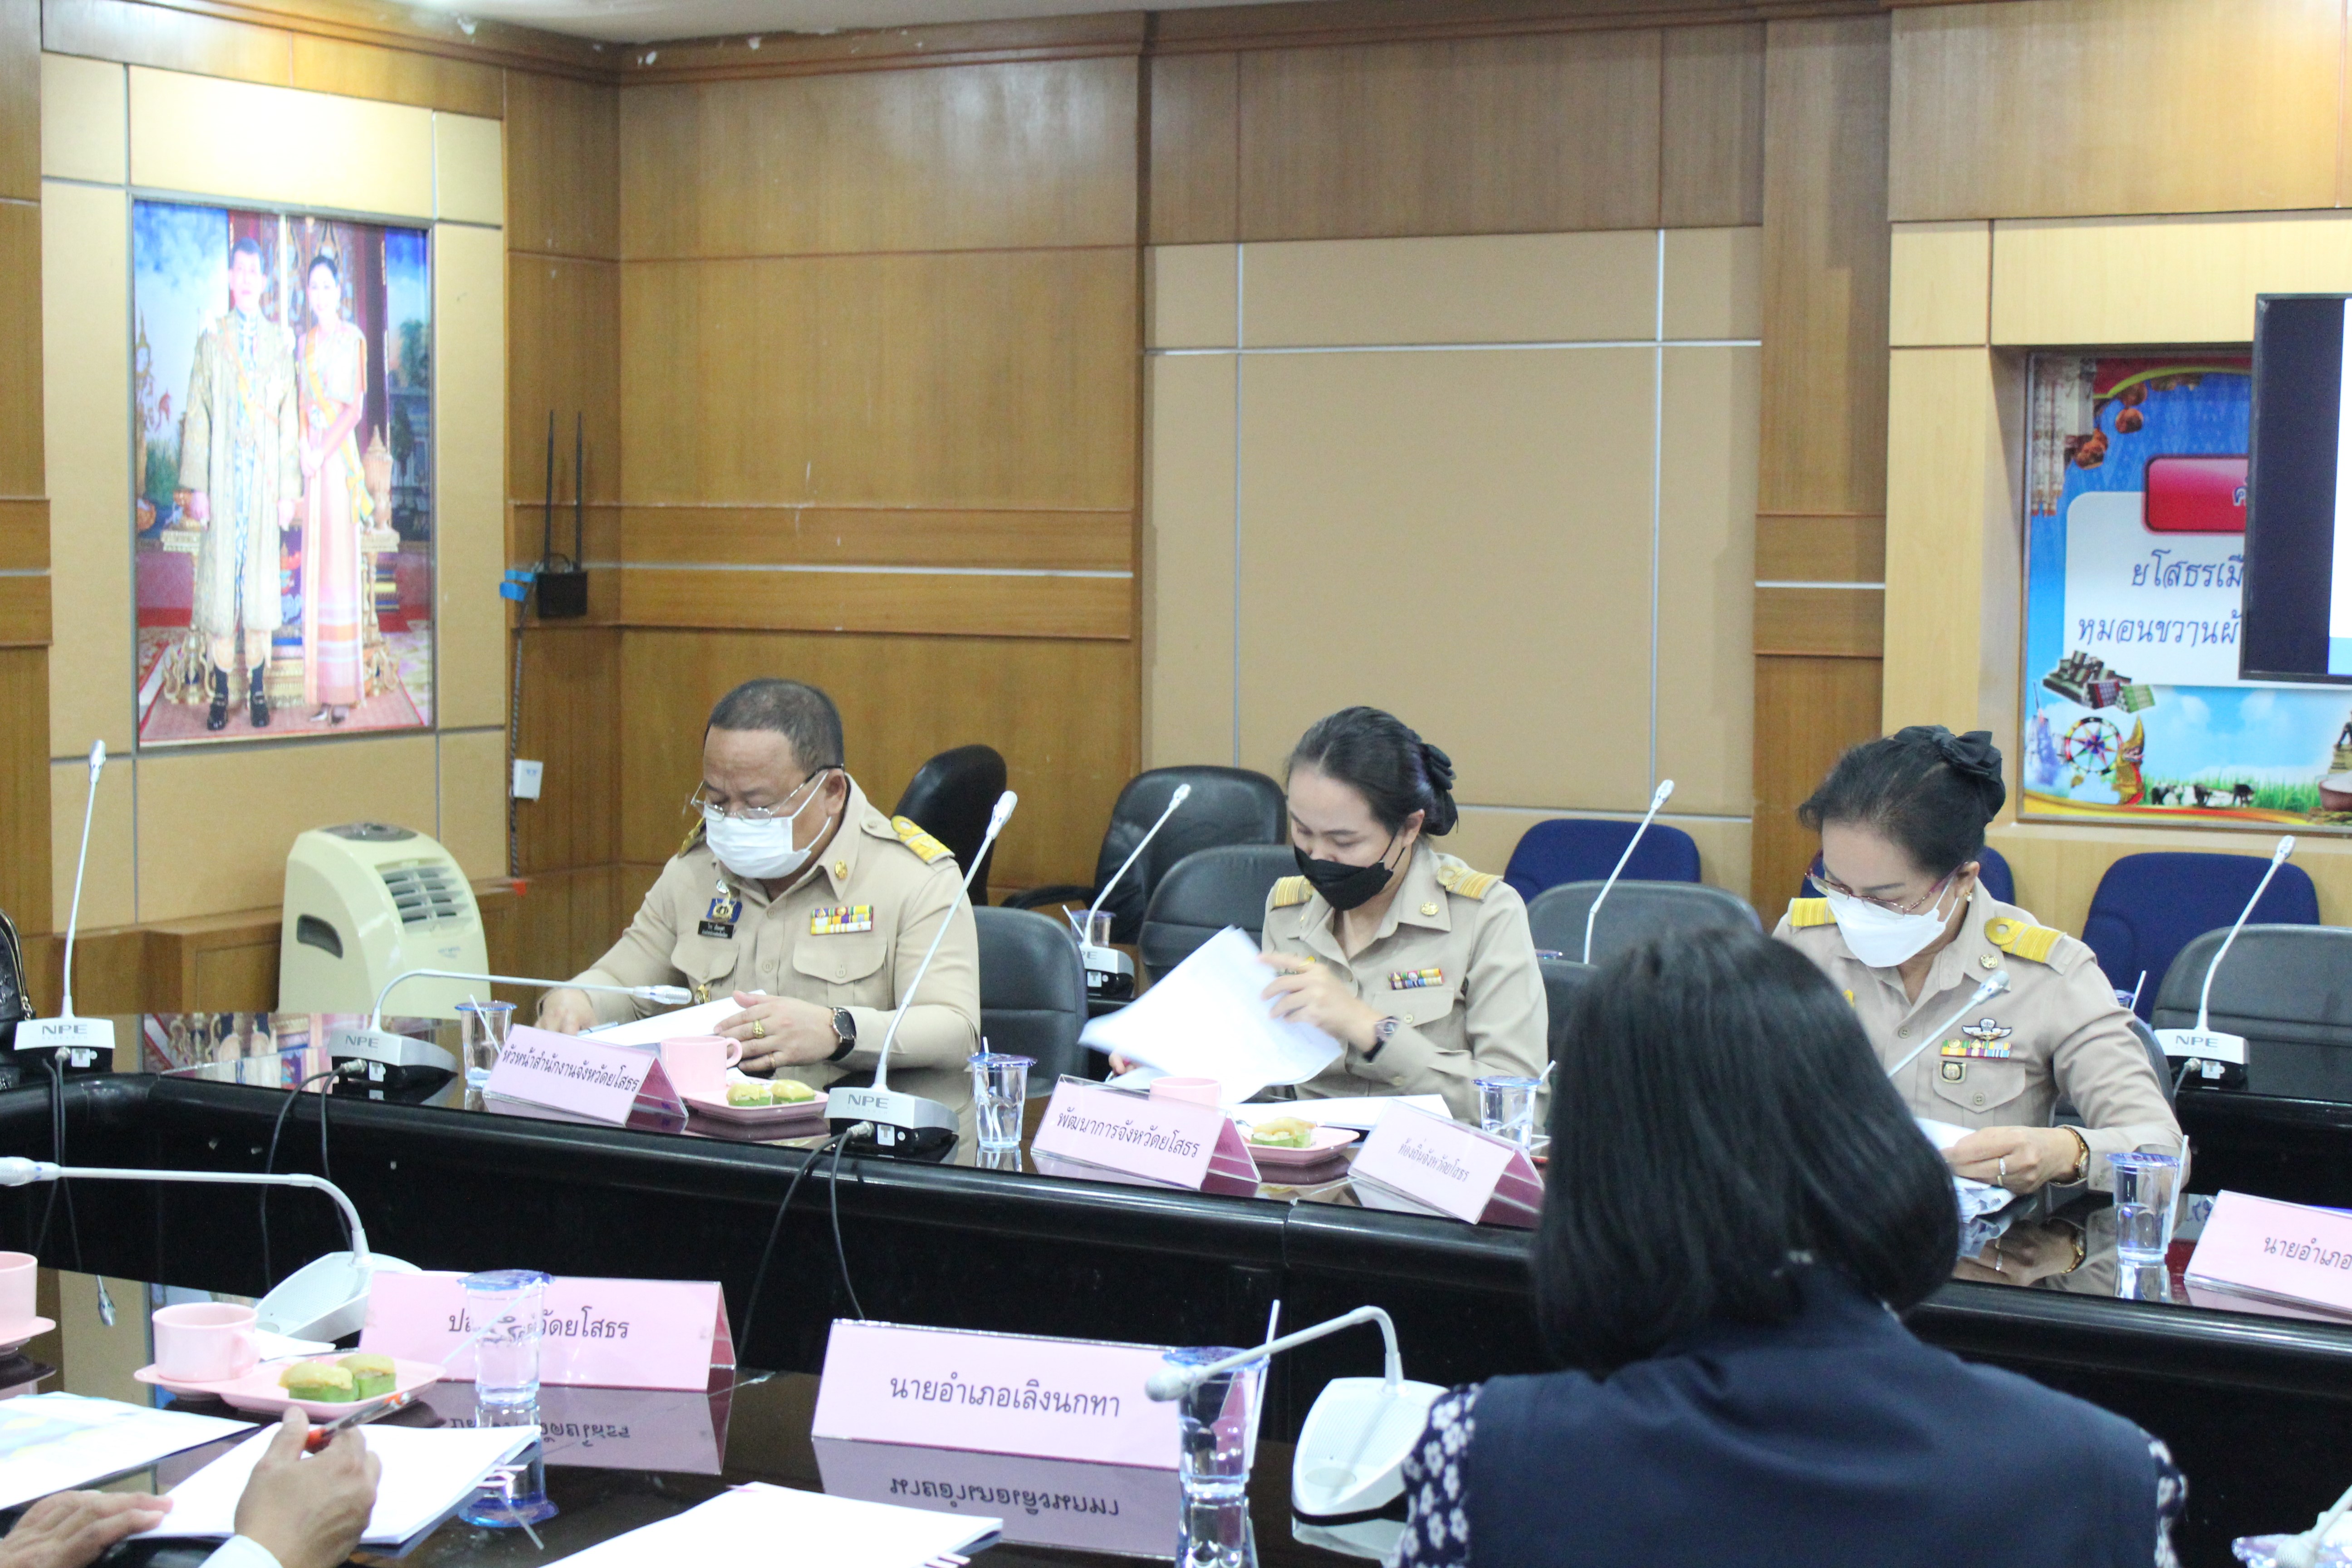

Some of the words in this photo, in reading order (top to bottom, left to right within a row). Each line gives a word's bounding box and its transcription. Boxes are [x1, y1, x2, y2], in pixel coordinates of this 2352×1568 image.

[42, 1024, 88, 1035] NPE
[345, 1034, 379, 1049] NPE
[2176, 1035, 2218, 1048] NPE
[501, 1044, 640, 1092] หัวหน้าสำนักงานจังหวัดยโสธร
[848, 1094, 889, 1109] NPE
[1057, 1107, 1200, 1158] พัฒนาการจังหวัดยโสธร
[1398, 1137, 1470, 1182] ท้องถิ่นจังหวัดยโสธร
[890, 1372, 1120, 1417] นายอำเภอเลิงนกทา
